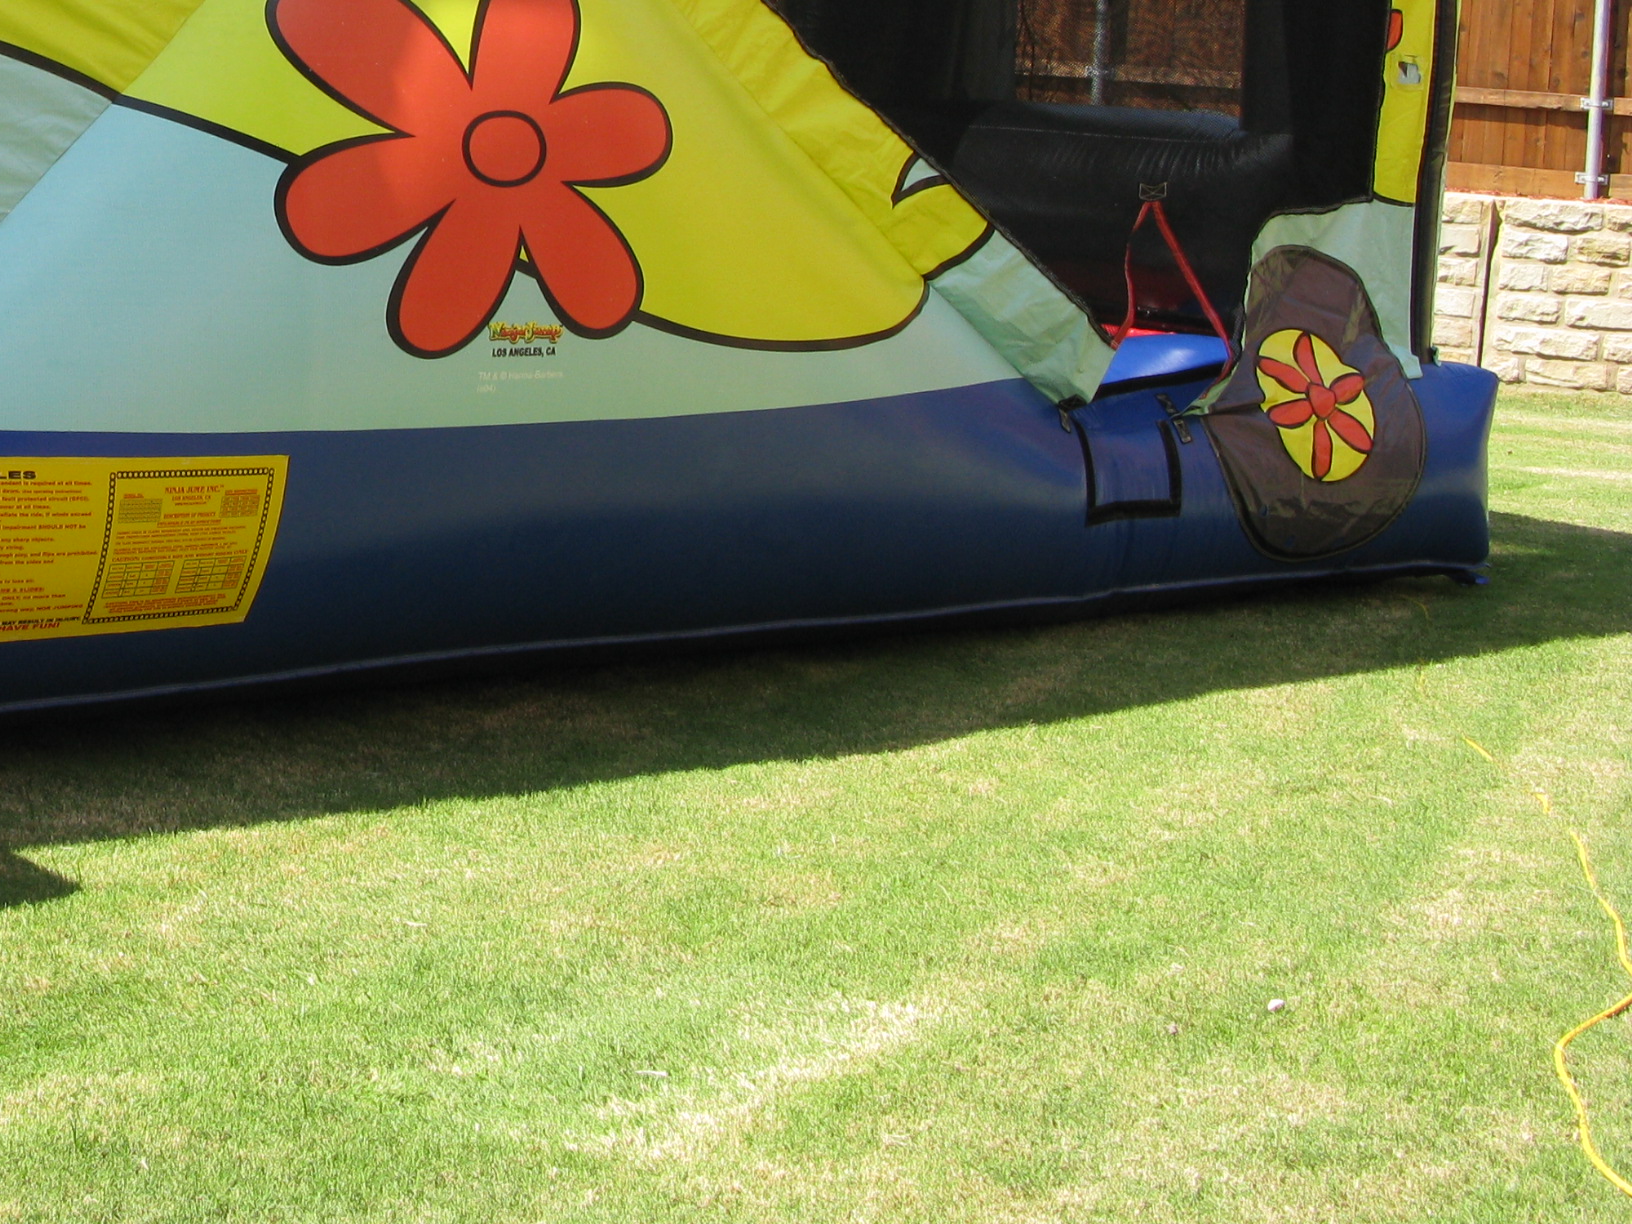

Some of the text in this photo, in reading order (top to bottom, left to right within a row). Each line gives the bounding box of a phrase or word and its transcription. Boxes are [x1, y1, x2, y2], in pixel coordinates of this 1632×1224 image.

[492, 346, 556, 358] LOS ANGELES, CA
